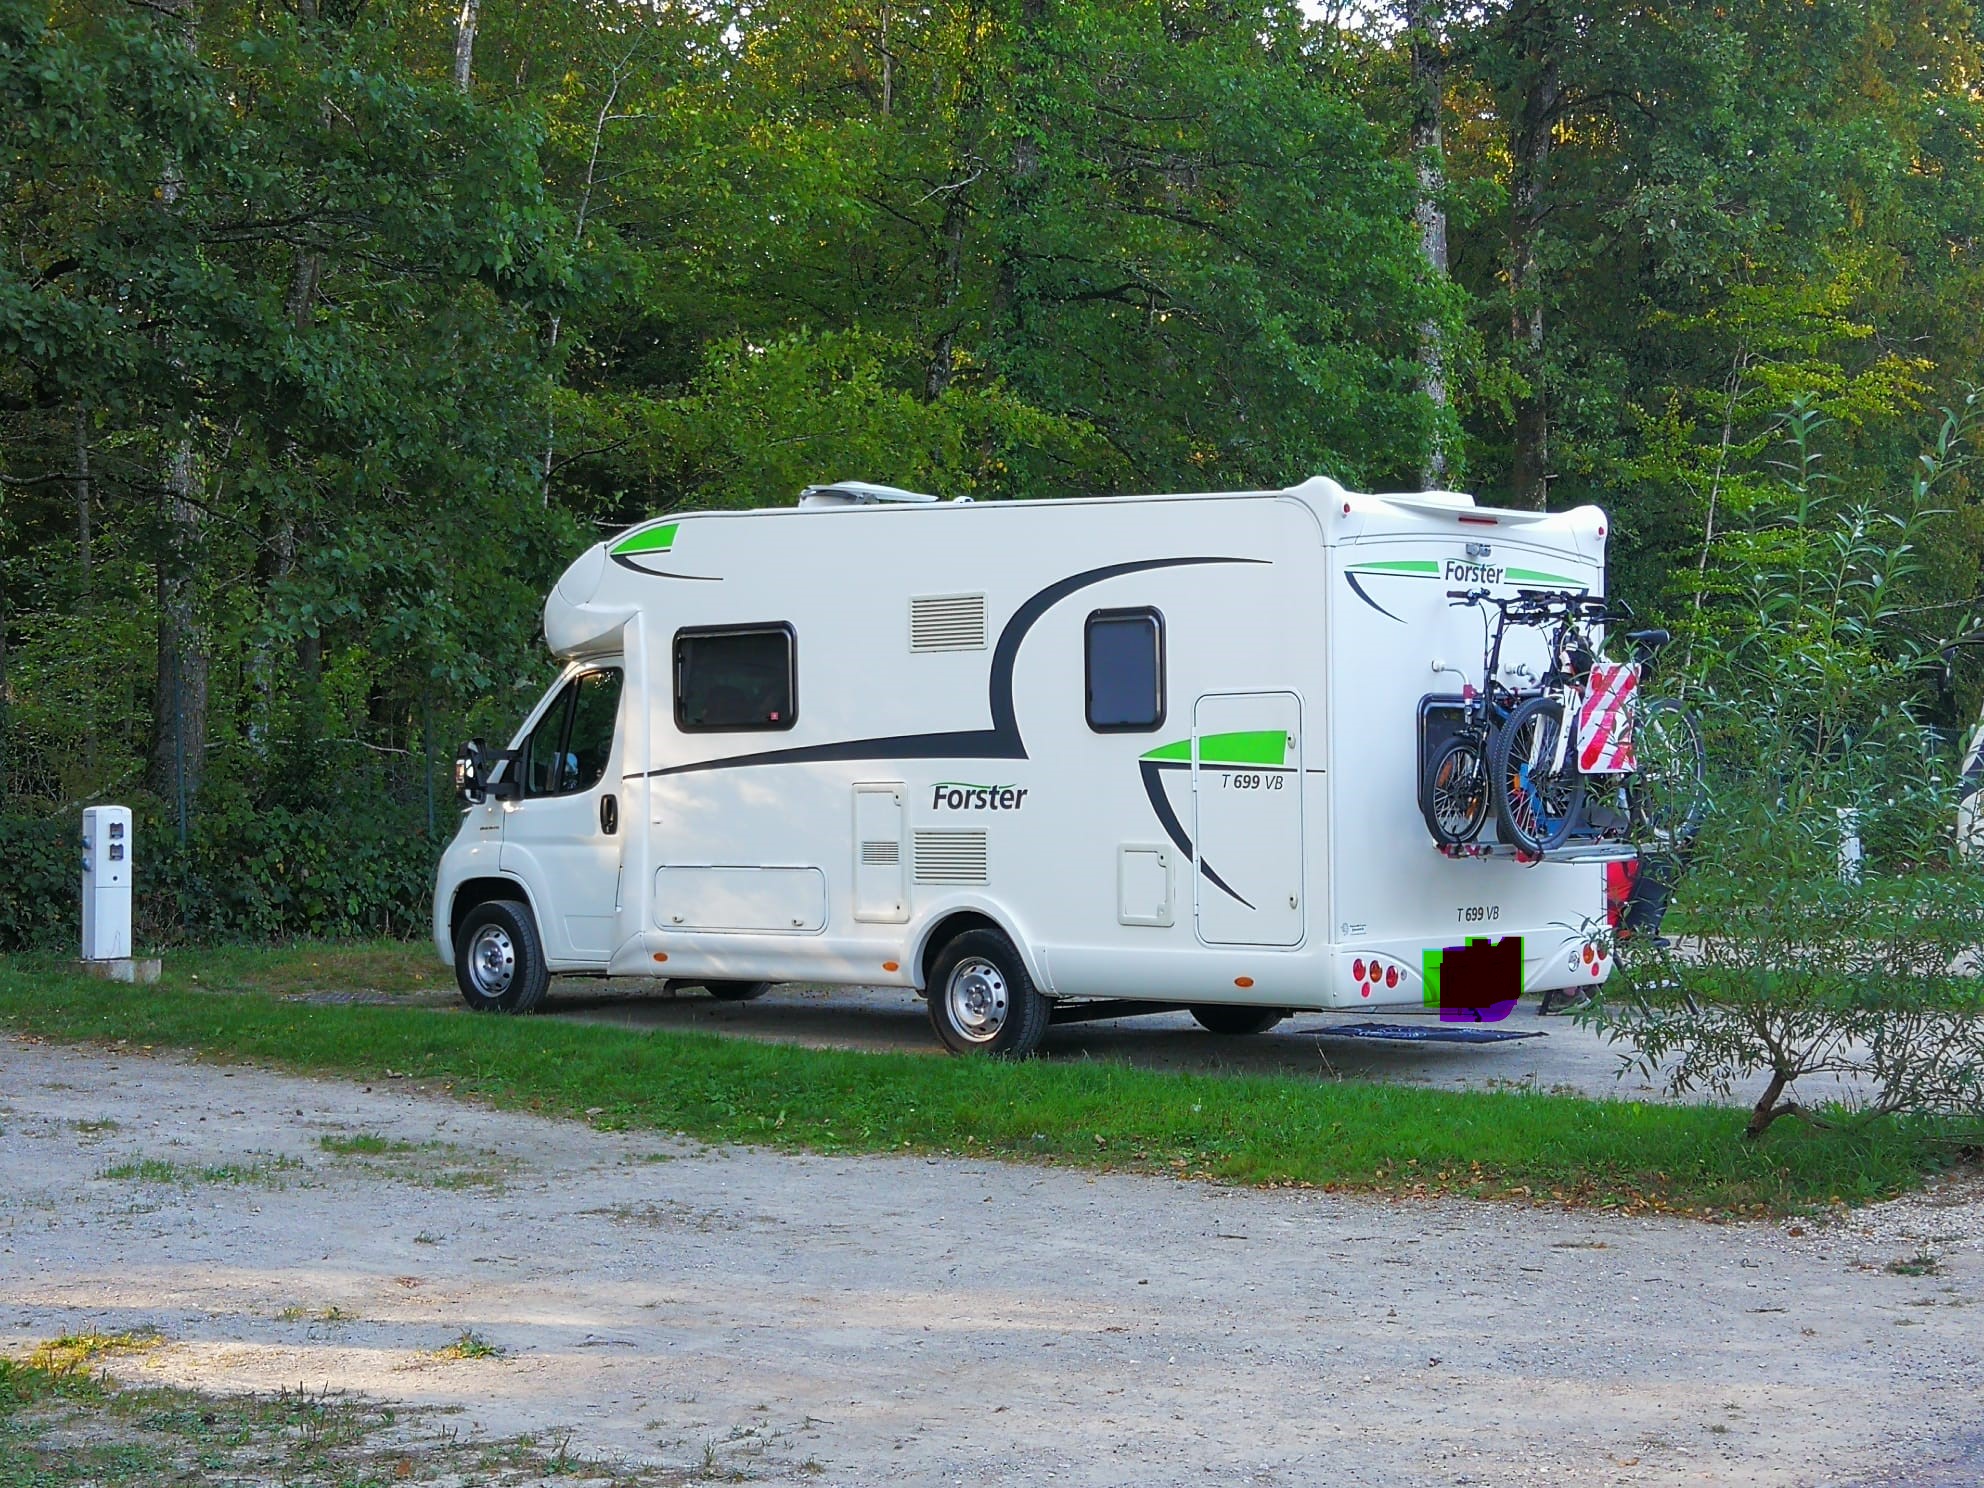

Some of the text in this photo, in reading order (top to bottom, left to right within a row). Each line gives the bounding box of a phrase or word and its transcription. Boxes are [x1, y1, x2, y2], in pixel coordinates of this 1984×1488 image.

[1445, 560, 1504, 584] Forster
[1222, 773, 1284, 790] T 699 VB
[931, 784, 1028, 810] Forster
[1457, 905, 1500, 922] T 699 VB
